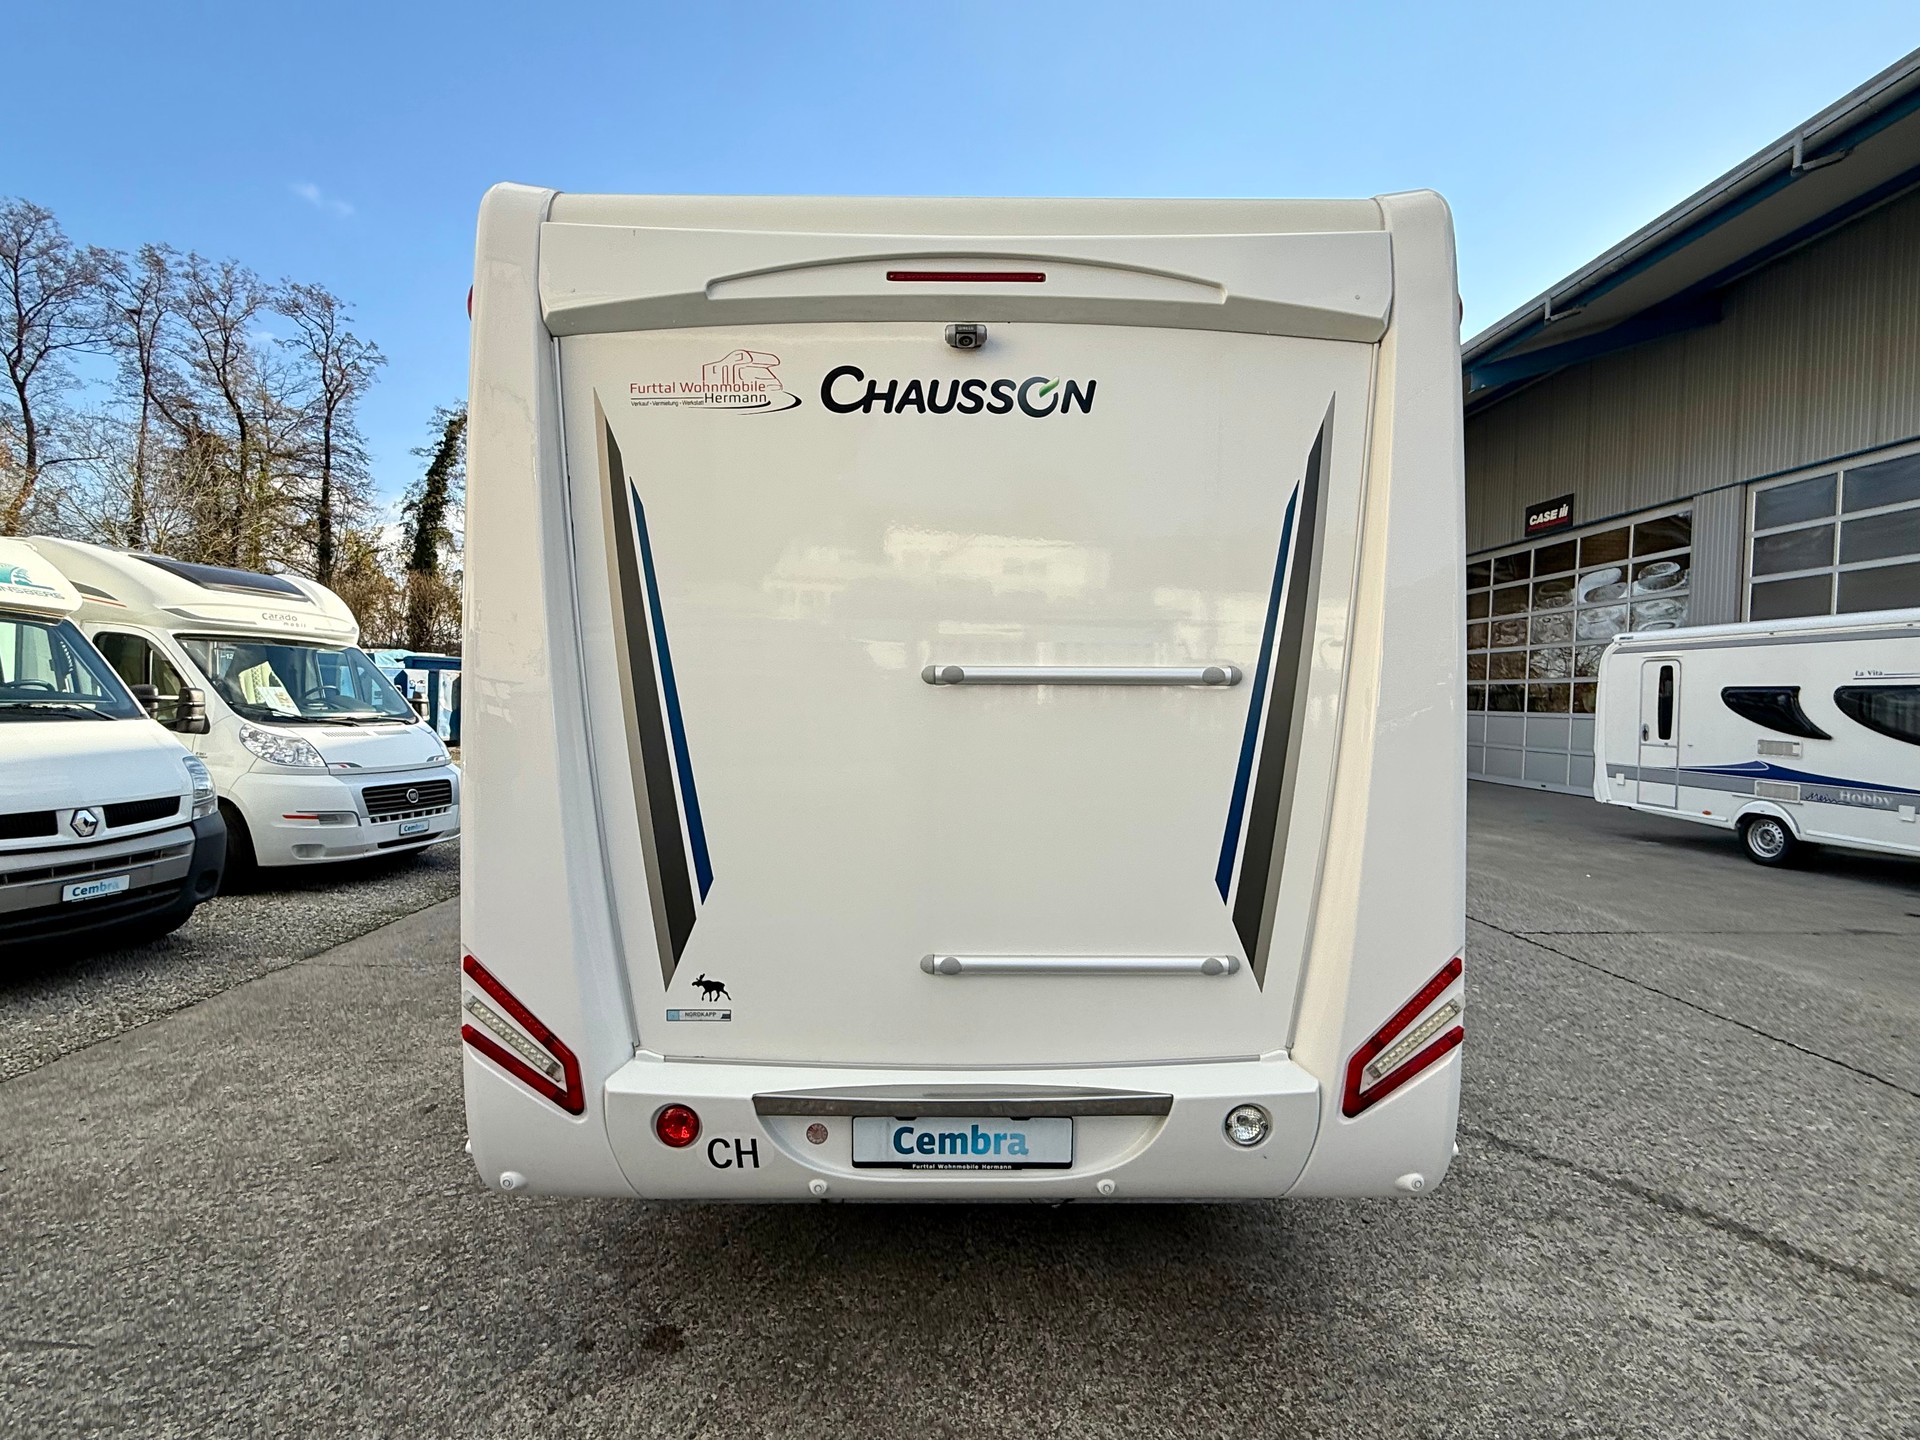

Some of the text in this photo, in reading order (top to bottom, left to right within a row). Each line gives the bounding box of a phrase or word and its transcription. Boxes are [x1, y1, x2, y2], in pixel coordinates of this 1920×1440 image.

[630, 381, 766, 394] Furttal Wohnmobile
[820, 364, 1097, 419] CHAUSSON
[704, 393, 767, 404] Hermann
[1529, 508, 1559, 526] CASE
[1840, 789, 1893, 806] Hobby
[72, 881, 120, 897] Cembra
[893, 1124, 1029, 1156] Cembra
[707, 1138, 760, 1169] CH
